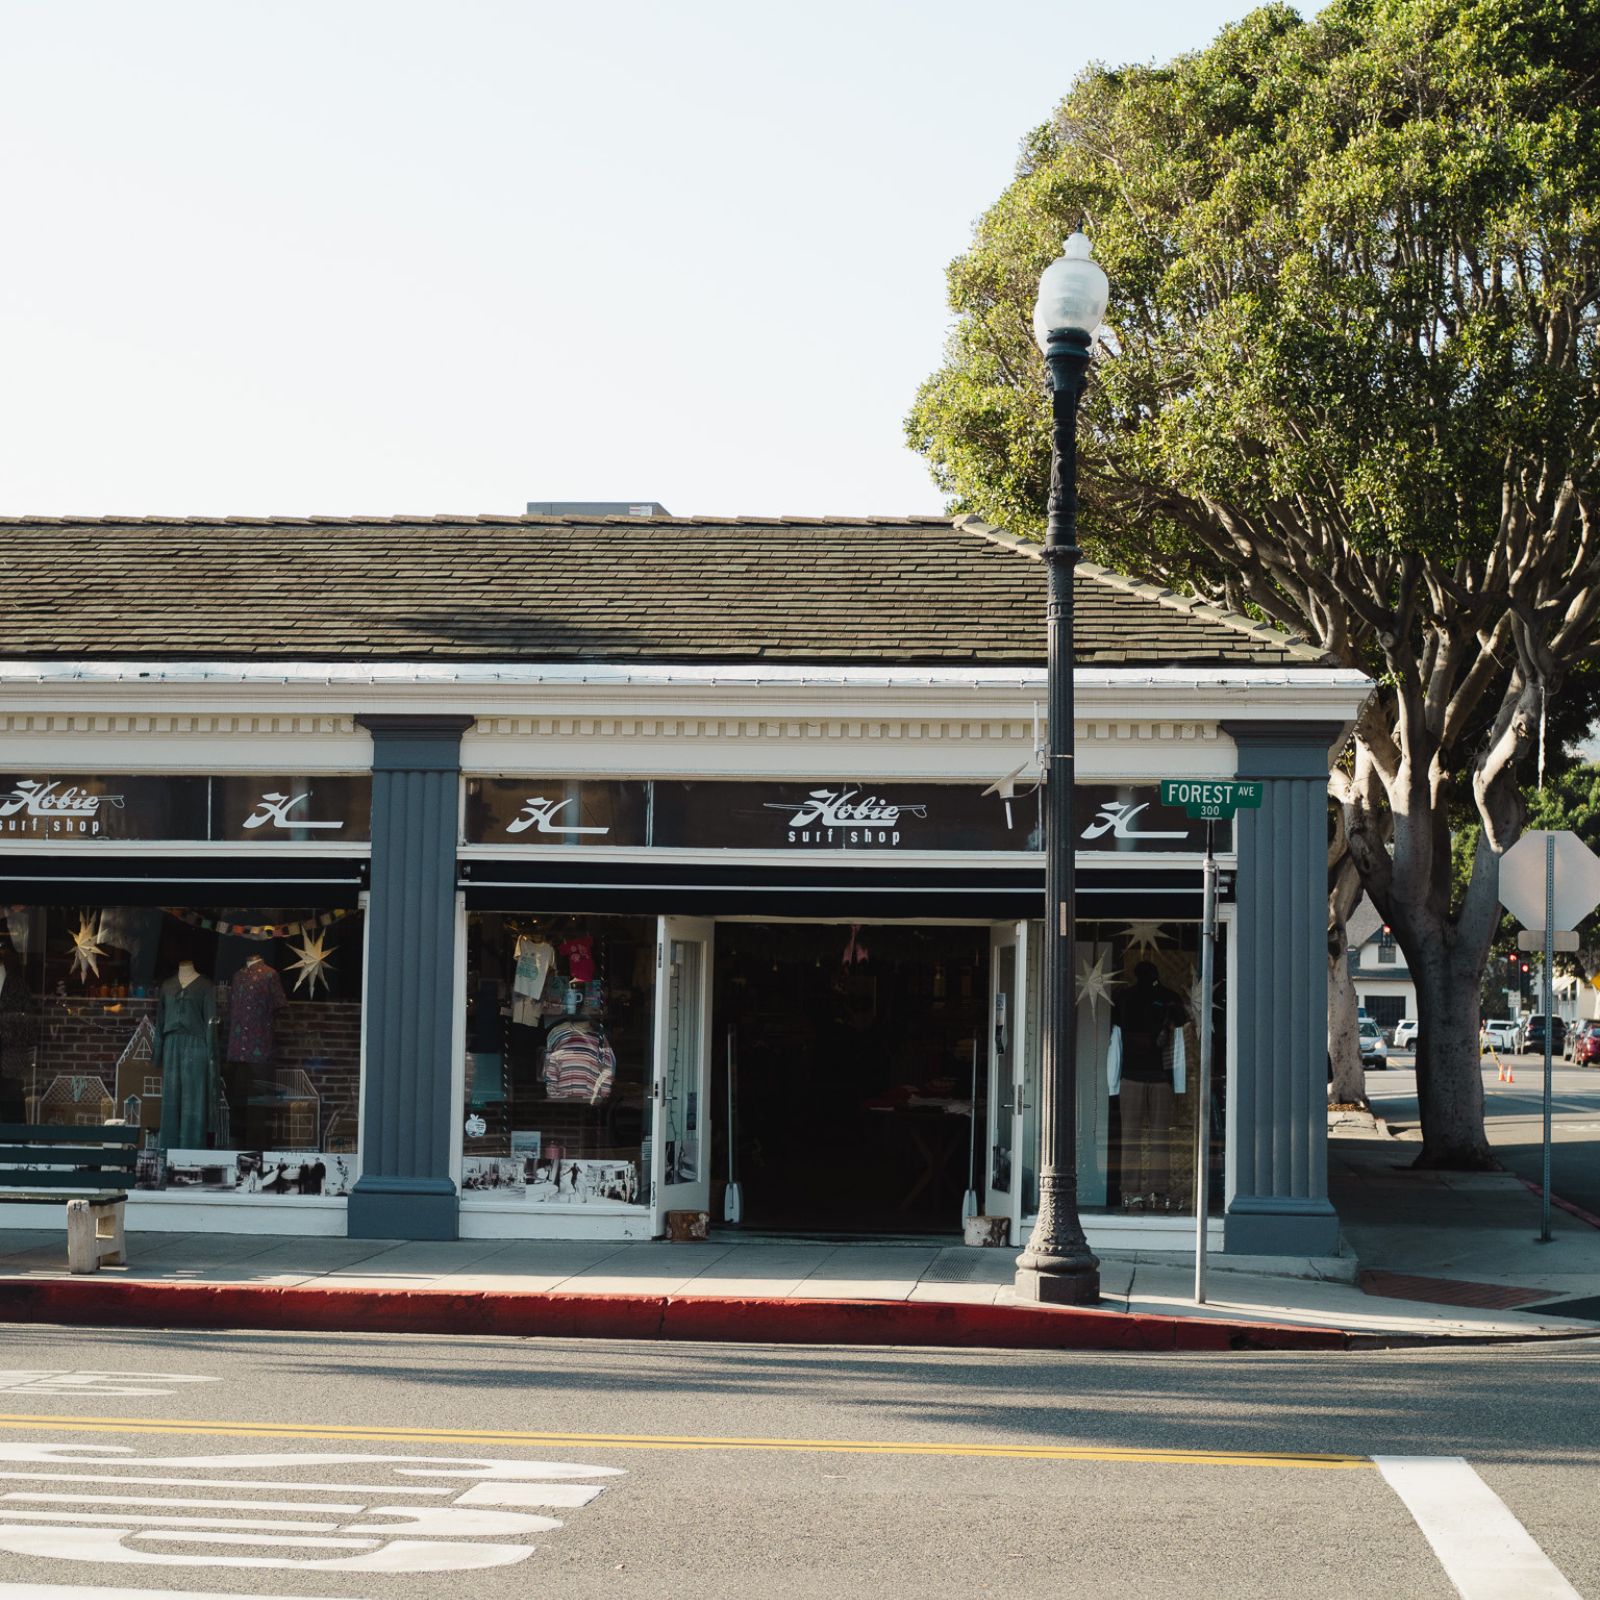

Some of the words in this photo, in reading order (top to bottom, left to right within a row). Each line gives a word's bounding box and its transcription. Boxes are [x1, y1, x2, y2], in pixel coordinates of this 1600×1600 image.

[0, 780, 100, 816] Hobie
[1168, 784, 1233, 803] FOREST
[1238, 786, 1255, 797] AVE
[788, 789, 900, 827] Hobie
[1200, 805, 1220, 816] 300
[53, 818, 100, 835] shop
[788, 828, 833, 843] surf
[850, 829, 901, 846] shop
